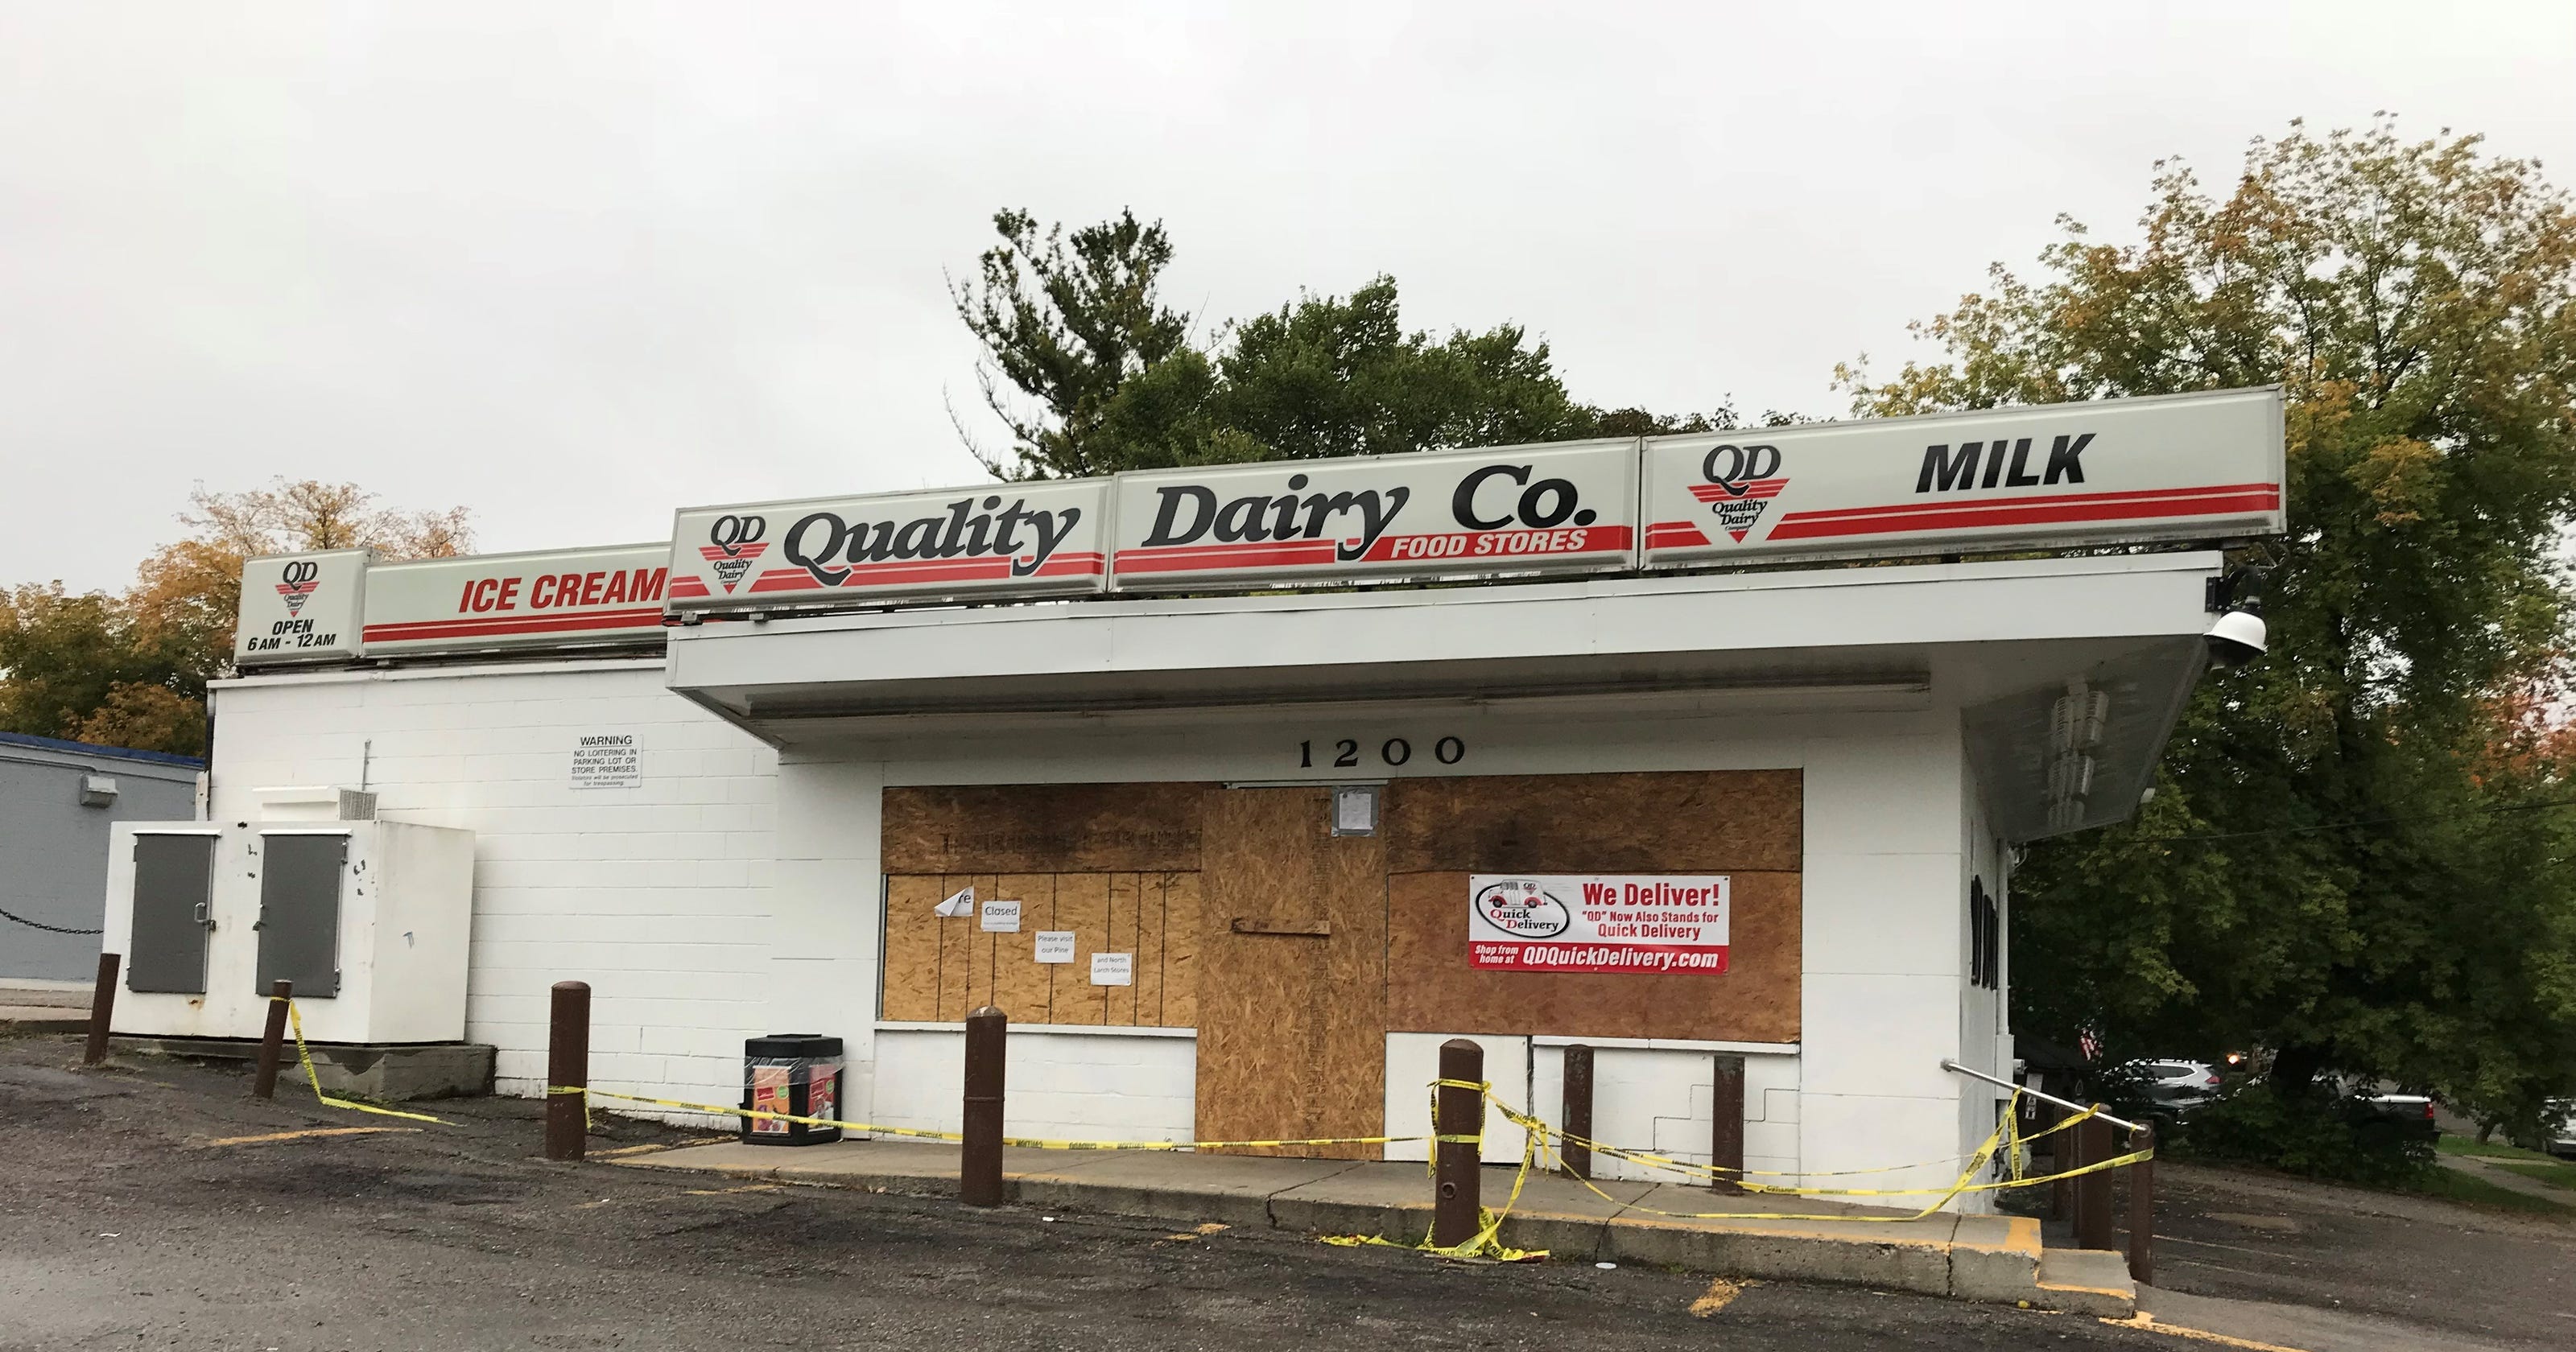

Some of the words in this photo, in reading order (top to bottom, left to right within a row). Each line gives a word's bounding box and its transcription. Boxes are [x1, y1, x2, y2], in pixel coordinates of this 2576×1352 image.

[1702, 443, 1781, 497] QD
[1914, 433, 2097, 494] MILK
[1141, 474, 1410, 562] Dairy
[1452, 464, 1598, 530] Co.
[1712, 499, 1768, 517] Quality
[1721, 513, 1759, 527] Dairy
[710, 515, 766, 556] QD
[784, 495, 1082, 587] Quality
[1390, 534, 1468, 559] FOOD
[1474, 529, 1589, 554] STORES
[713, 558, 753, 574] Quality
[283, 561, 318, 591] QD
[718, 569, 745, 582] Dairy
[459, 577, 522, 613] ICE
[530, 567, 668, 609] CREAM
[272, 619, 314, 636] OPEN
[580, 735, 632, 745] WARNING
[588, 748, 626, 756] LOITERING
[1300, 736, 1465, 768] 1200
[1583, 884, 1616, 906] We
[1624, 883, 1719, 906] Deliver!
[985, 905, 1018, 916] Closed
[1490, 909, 1530, 921] Quick
[1610, 913, 1633, 922] Now
[1635, 912, 1659, 922] Also
[1662, 912, 1700, 923] Stands
[1703, 912, 1719, 923] for
[1506, 920, 1559, 932] Delivery
[1598, 923, 1637, 938] Quick
[1641, 924, 1701, 942] Delivery
[1475, 945, 1498, 955] Shop
[1498, 945, 1520, 954] from
[1479, 954, 1505, 964] home
[1505, 955, 1515, 963] at
[1522, 946, 1719, 971] QDQuickDelivery.com
